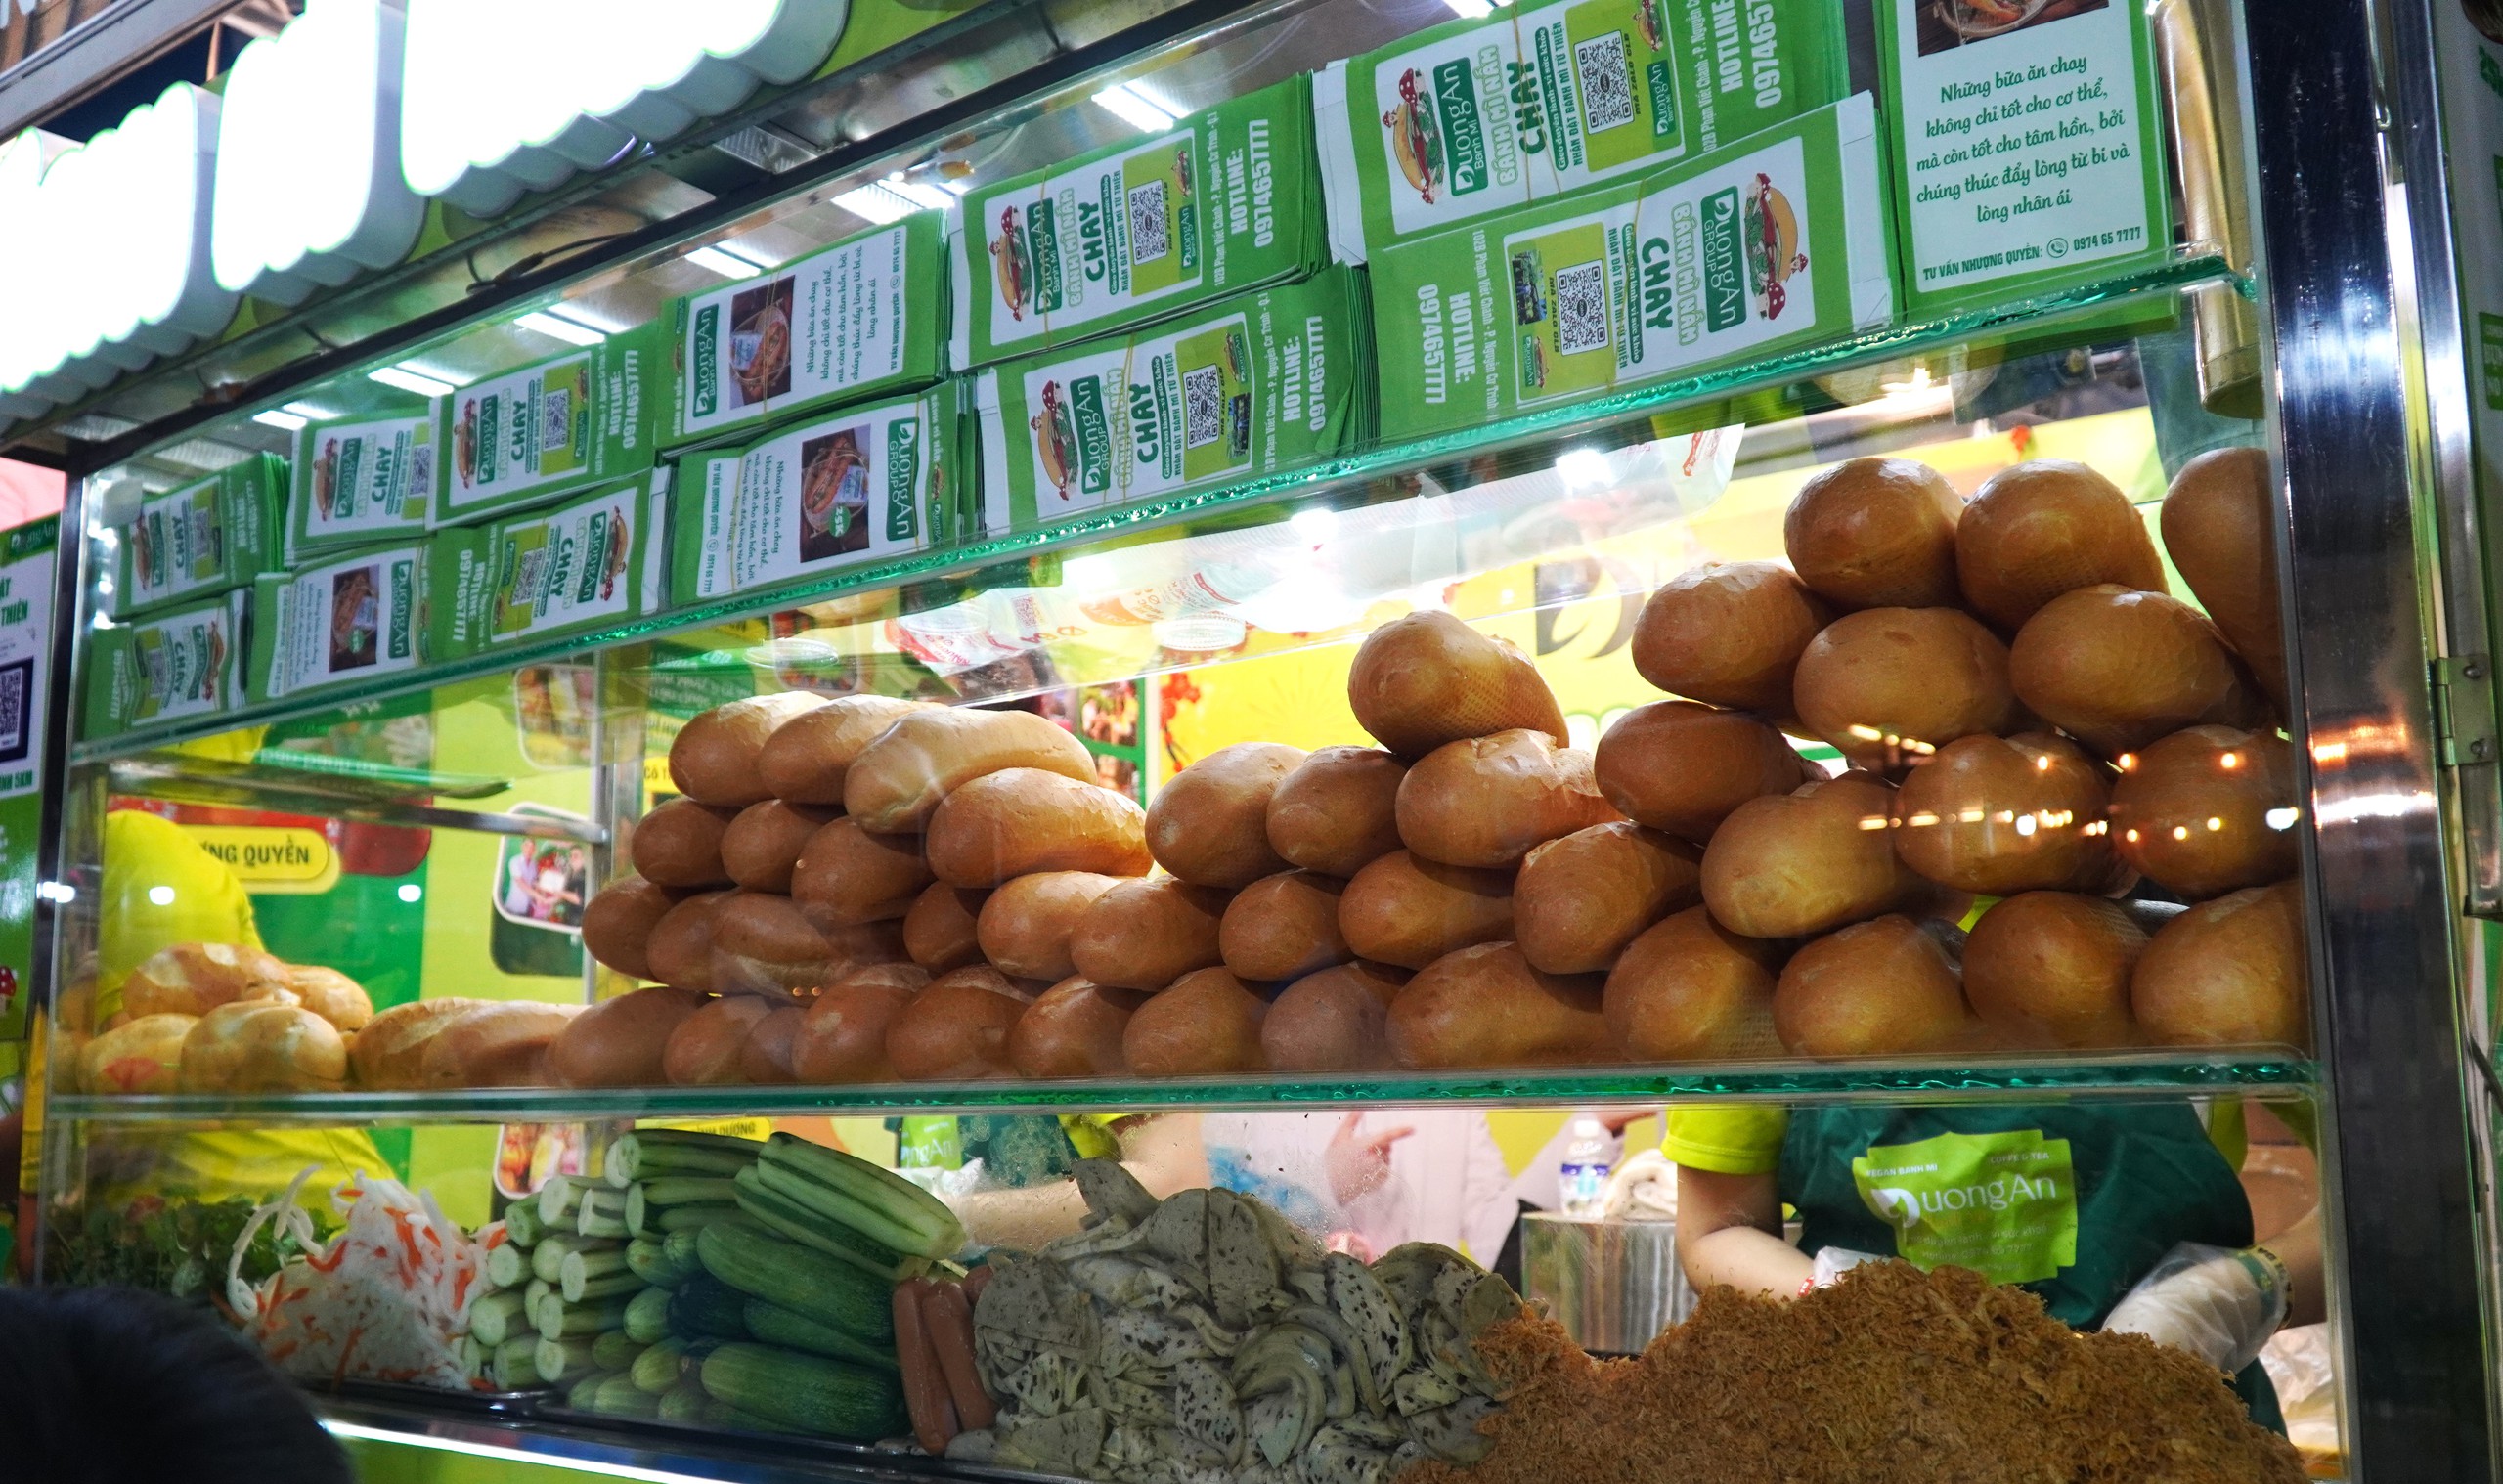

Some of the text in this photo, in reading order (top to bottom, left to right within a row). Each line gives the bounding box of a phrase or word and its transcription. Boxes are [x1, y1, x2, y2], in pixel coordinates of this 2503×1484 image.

[1552, 22, 1584, 166] NHẬN ĐẶT BÁNH MÌ TỪ THIỆN
[1628, 61, 1638, 90] ZALO
[1650, 64, 1668, 135] DuongAn
[1940, 56, 2087, 103] Những bữa ăn chay
[1441, 65, 1476, 191] DuongAn
[1473, 44, 1518, 186] BÁNH MÌ NẤM
[1506, 61, 1547, 154] CHAY
[1551, 114, 1565, 146] duyên
[1926, 77, 2108, 138] không chỉ tốt cho cơ thể,
[1556, 147, 1566, 169] Gieo
[1916, 109, 2126, 171] mà còn tốt cho tâm hồn, bởi
[1226, 148, 1248, 235] HOTLINE:
[1249, 118, 1274, 248] 0974657777
[1916, 143, 2130, 203] chúng thúc đẩy lòng từ bi và
[1977, 188, 2073, 223] lòng nhân ái
[1031, 205, 1053, 309] DuongAn
[1078, 202, 1105, 282] CHAY
[1472, 230, 1486, 253] 102B
[1473, 254, 1488, 279] Phạm
[1607, 227, 1620, 255] NHẬN
[1611, 257, 1623, 277] ĐẶT
[1704, 219, 1717, 272] GROUP
[1711, 193, 1740, 325] DuongAn
[1922, 226, 2141, 281] TƯ VẤN NHƯỢNG QUYỀN: 0974 65 7777
[808, 281, 818, 303] chay
[1613, 281, 1625, 306] BÁNH
[1642, 237, 1673, 328] CHAY
[1671, 201, 1706, 346] BÁNH MÌ NẤM
[696, 309, 714, 412] DuongAn
[806, 340, 816, 373] Những
[1418, 284, 1446, 403] 0974657777
[1449, 291, 1476, 383] HOTLINE:
[1283, 336, 1301, 422] HOTLINE:
[1306, 316, 1326, 432] 0974657777
[511, 400, 527, 461] CHAY
[1076, 381, 1102, 489] DuongAn
[1097, 427, 1109, 471] GROUP
[1129, 383, 1159, 463] CHAY
[372, 447, 392, 502] CHAY
[889, 441, 899, 487] GROUP
[892, 422, 916, 535] DuongAn
[172, 516, 185, 568] CHAY
[834, 506, 844, 537] 25K
[549, 537, 573, 596] CHAY
[582, 514, 605, 599] DuongAn
[394, 563, 411, 654] DuongAn
[244, 834, 310, 868] QUYỀN
[1899, 1164, 1924, 1176] BANH
[2031, 1152, 2049, 1161] TEA
[1871, 1174, 2056, 1228] DuongAn
